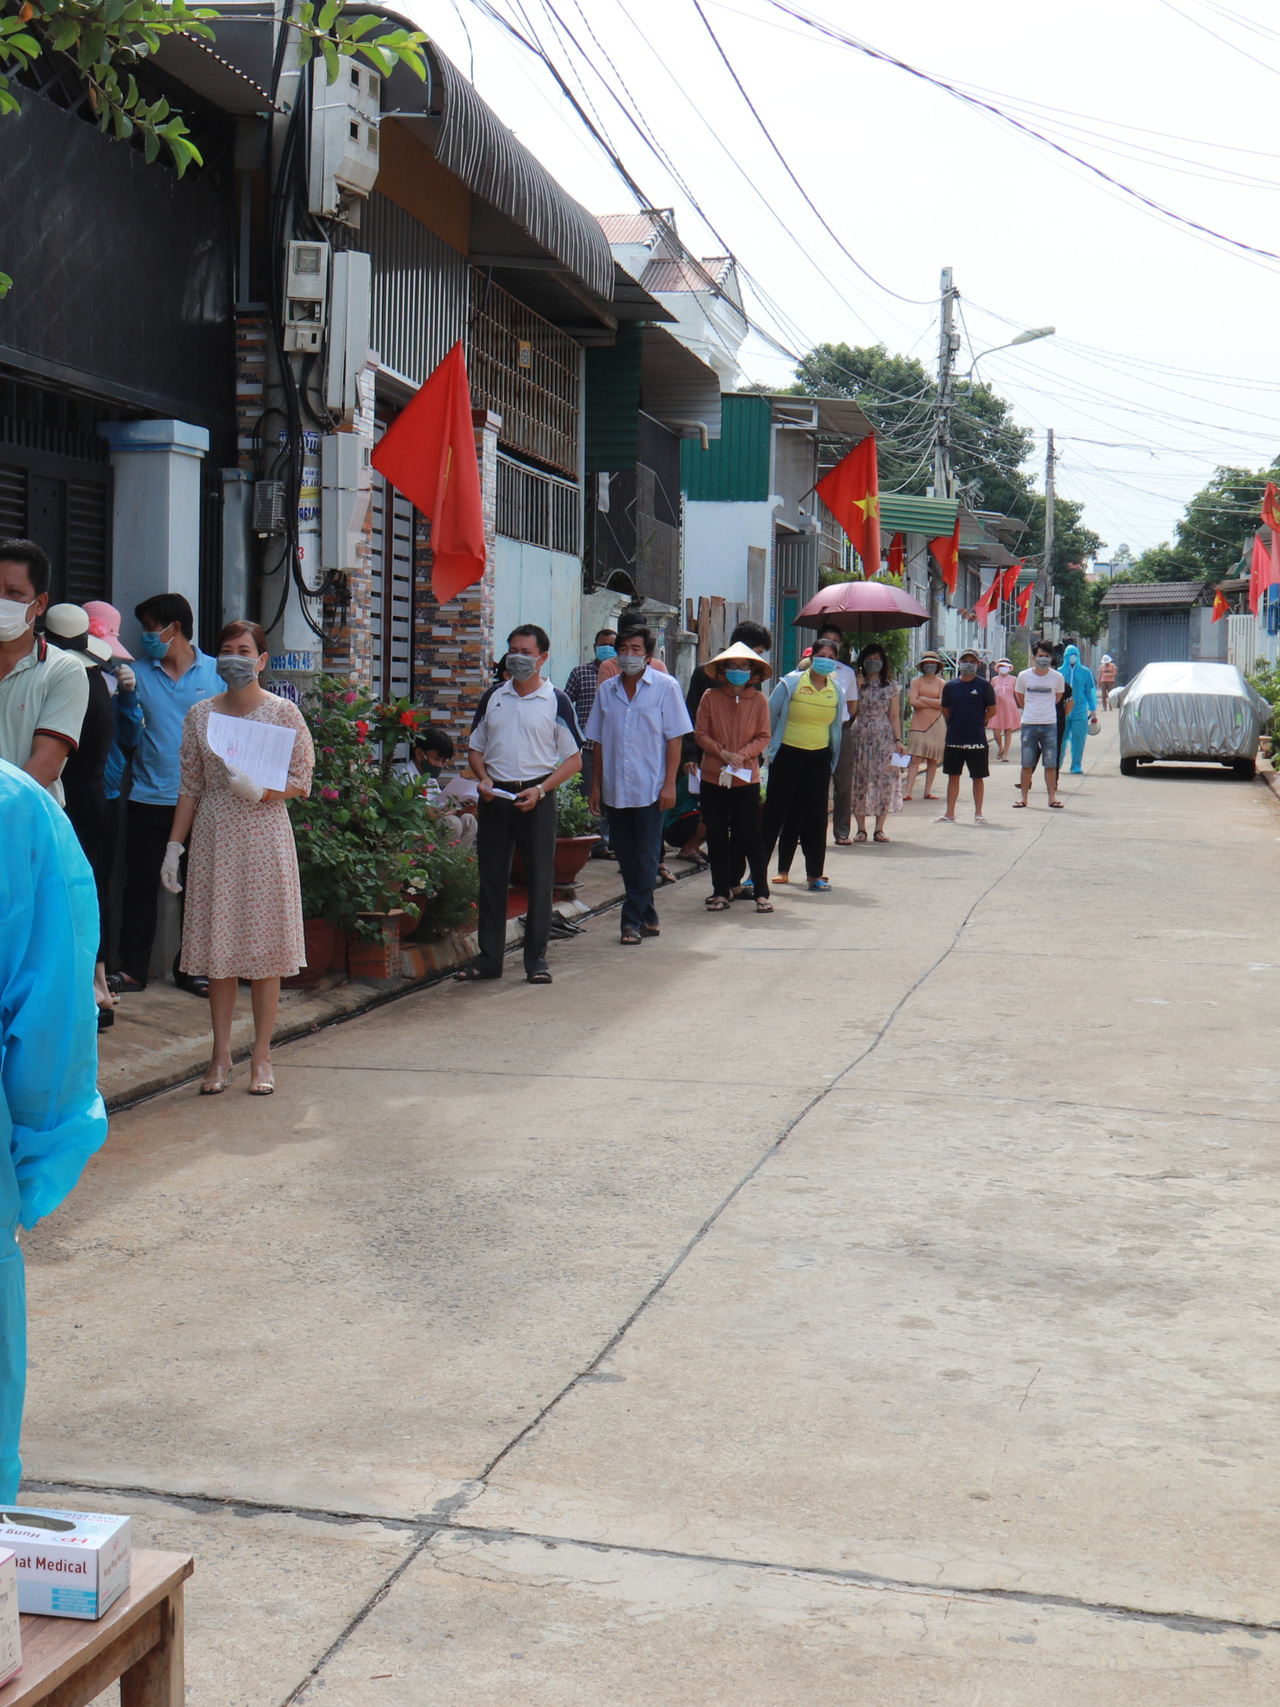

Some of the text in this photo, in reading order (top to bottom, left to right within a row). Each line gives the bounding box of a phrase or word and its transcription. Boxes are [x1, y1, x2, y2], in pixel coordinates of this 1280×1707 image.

[5, 1529, 41, 1539] Hung
[15, 1556, 87, 1574] at Medical
